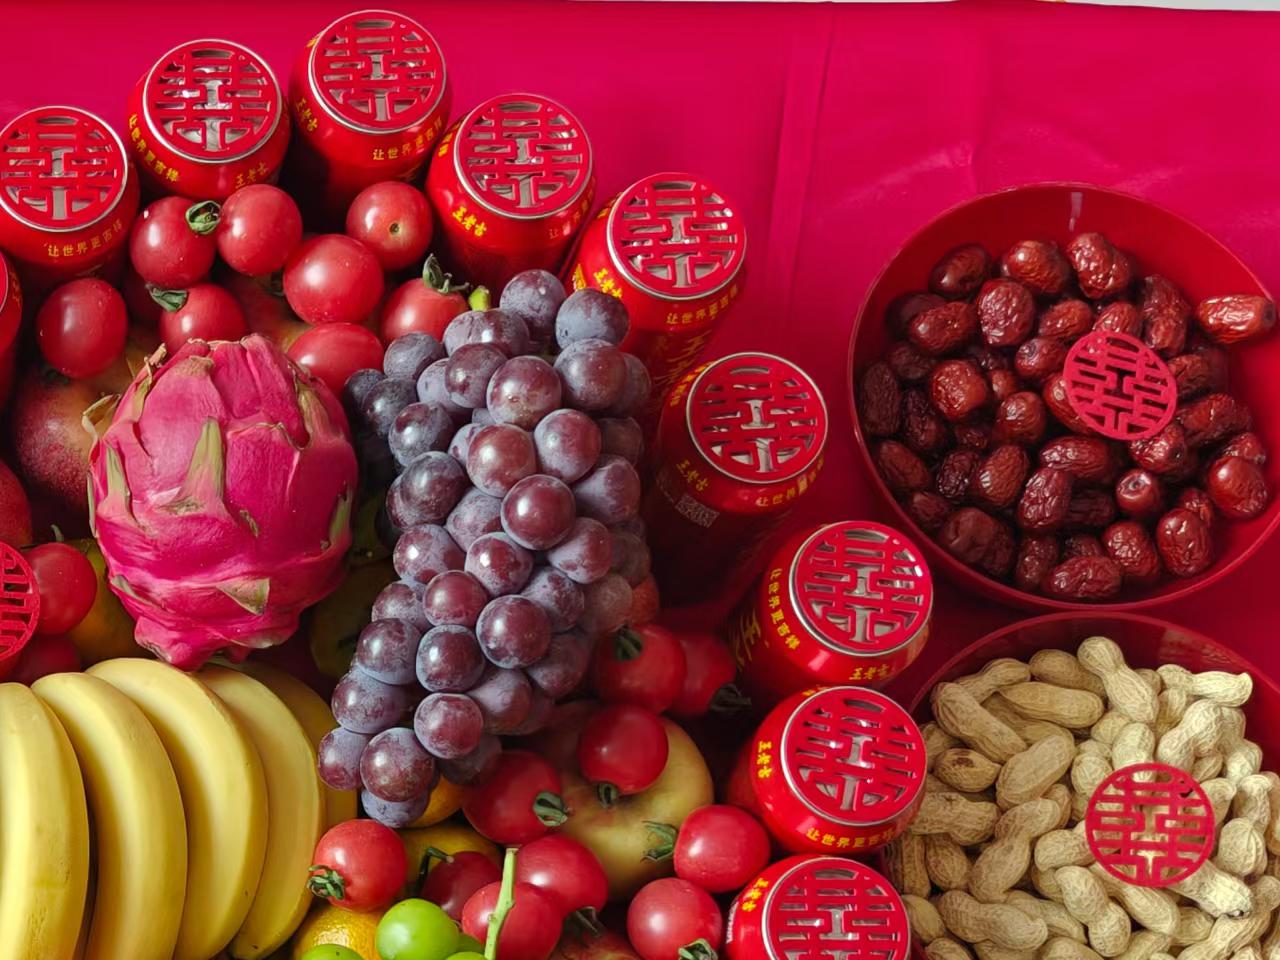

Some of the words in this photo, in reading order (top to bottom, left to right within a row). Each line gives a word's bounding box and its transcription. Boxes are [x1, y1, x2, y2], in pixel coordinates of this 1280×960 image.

[46, 217, 123, 258] 让世界更吉祥
[450, 206, 486, 238] 王老吉
[592, 267, 622, 299] 王老吉
[674, 458, 710, 492] 王老吉
[848, 662, 891, 681] 王老吉
[755, 739, 773, 781] 王老吉
[741, 877, 770, 913] 王老吉
